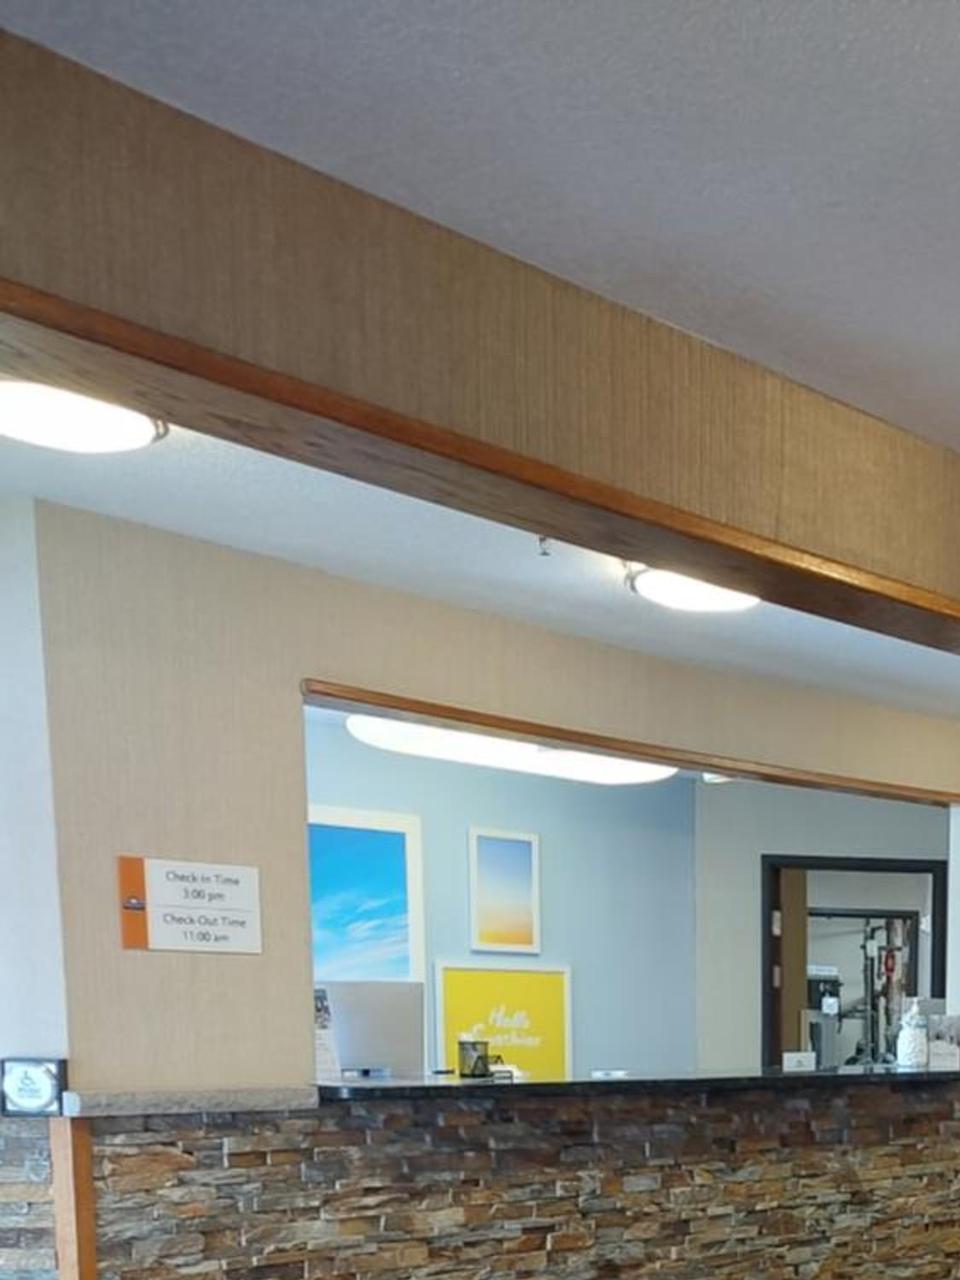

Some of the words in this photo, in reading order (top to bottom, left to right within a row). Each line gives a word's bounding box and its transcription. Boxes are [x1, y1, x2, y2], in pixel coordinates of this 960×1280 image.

[213, 873, 240, 886] Time
[207, 891, 226, 902] pm
[220, 916, 247, 928] Time
[213, 933, 230, 943] am
